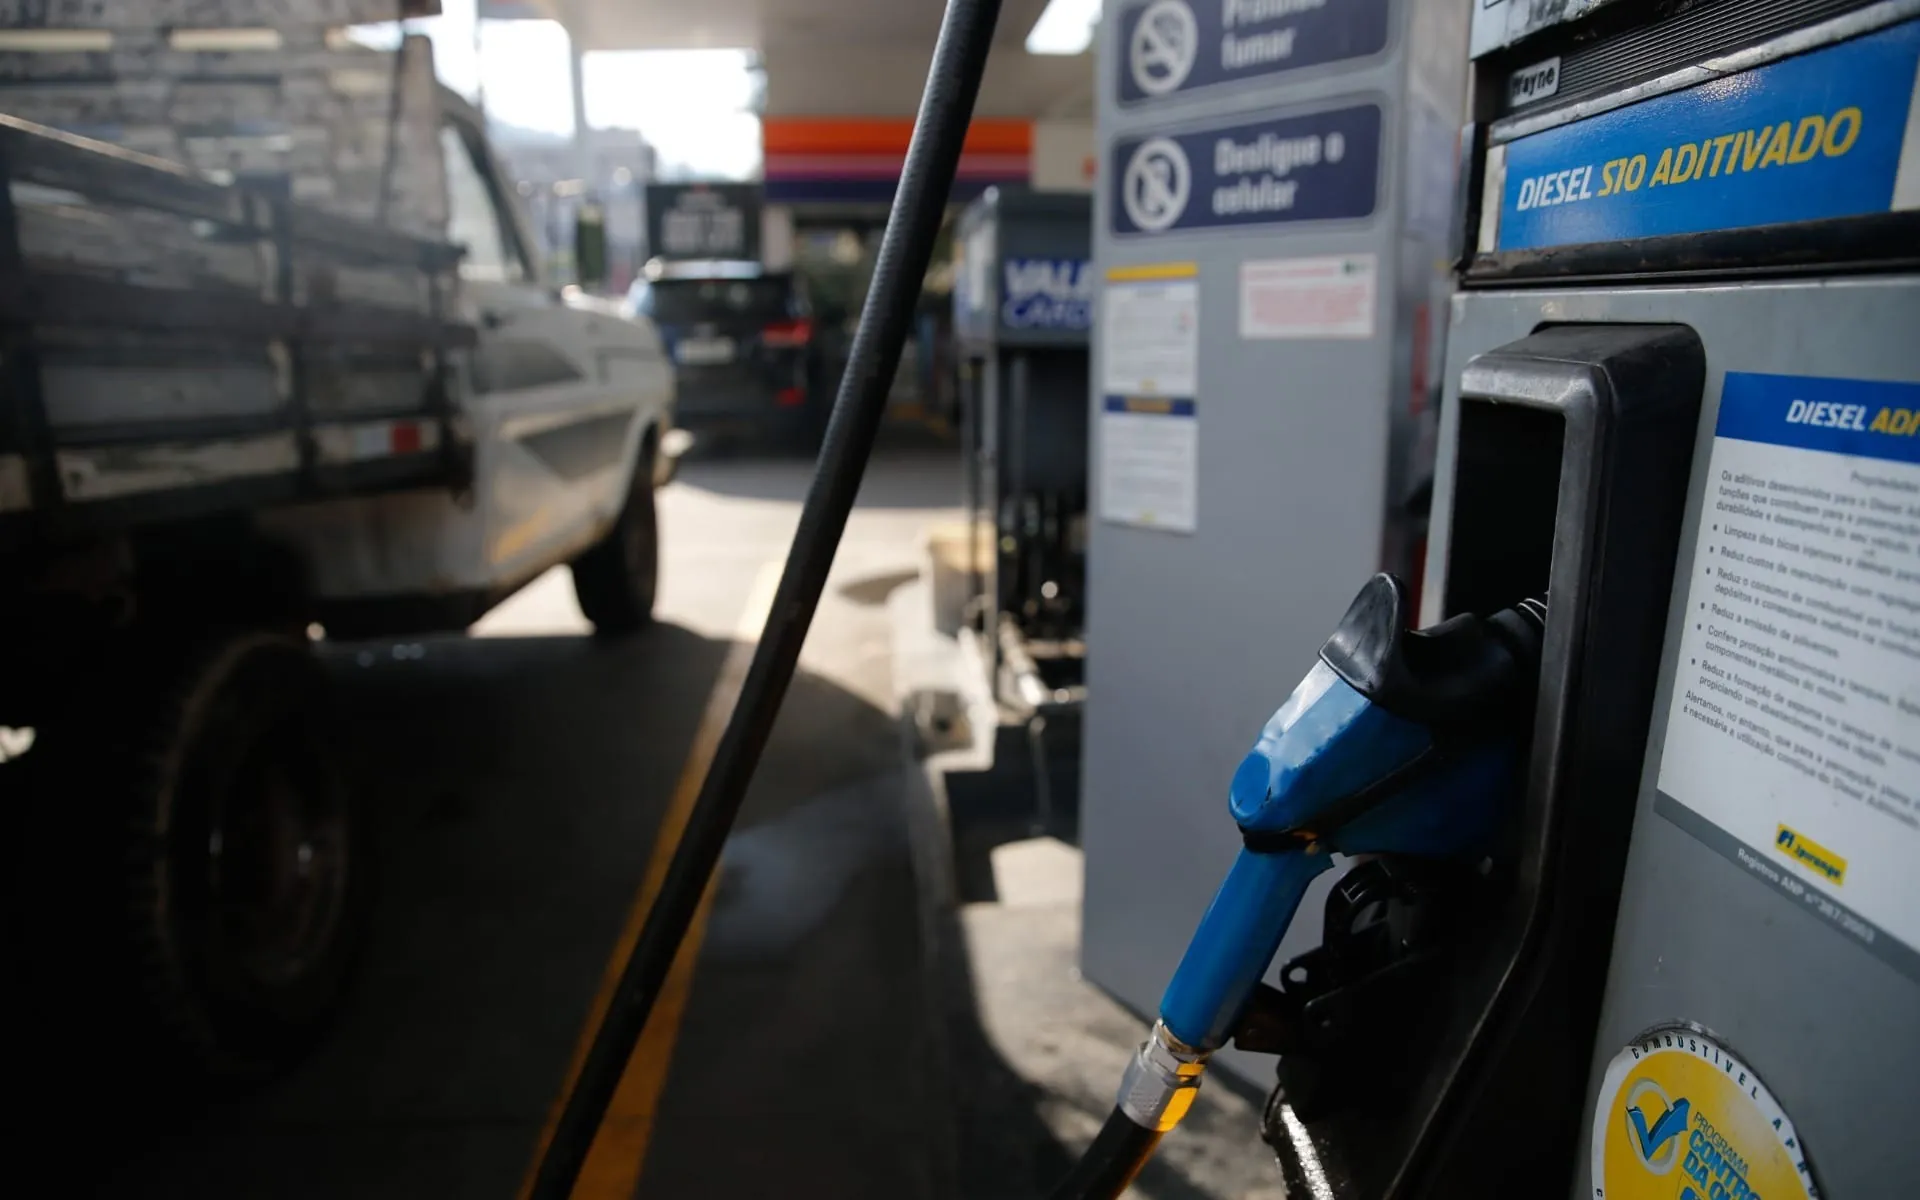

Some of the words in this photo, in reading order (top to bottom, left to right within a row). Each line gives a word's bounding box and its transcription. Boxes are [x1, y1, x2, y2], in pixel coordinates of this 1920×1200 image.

[1512, 67, 1555, 97] Wayne
[1214, 132, 1321, 176] Desligue
[1517, 165, 1595, 211] DIESEL
[1597, 153, 1647, 197] S10
[1649, 107, 1863, 188] ADITIVADO
[1212, 174, 1298, 216] celular
[1786, 400, 1867, 431] DIESEL
[1721, 470, 1732, 481] Os
[1734, 473, 1766, 488] aditivos
[1719, 484, 1750, 500] funções
[1752, 494, 1767, 505] que
[1716, 501, 1763, 519] durabilidade
[1724, 524, 1757, 541] Limpeza
[1759, 533, 1774, 546] dos
[1777, 537, 1800, 552] bicos
[1721, 546, 1744, 561] Reduz
[1747, 556, 1774, 571] custos
[1718, 567, 1741, 584] Reduz
[1715, 583, 1752, 603] depósitos
[1711, 603, 1734, 620] Reduz
[1705, 641, 1757, 668] componentes
[1739, 640, 1776, 660] proteção
[1699, 676, 1743, 702] propiciando
[1744, 696, 1759, 708] um
[1702, 659, 1725, 678] Reduz
[1734, 673, 1772, 698] formação
[1726, 711, 1737, 722] no
[1737, 731, 1775, 757] utilização
[1781, 876, 1804, 896] ANP
[1632, 1035, 1758, 1099] COMBUSTÍVEL
[1694, 1111, 1748, 1179] PROGRAMA
[1683, 1150, 1708, 1192] DA
